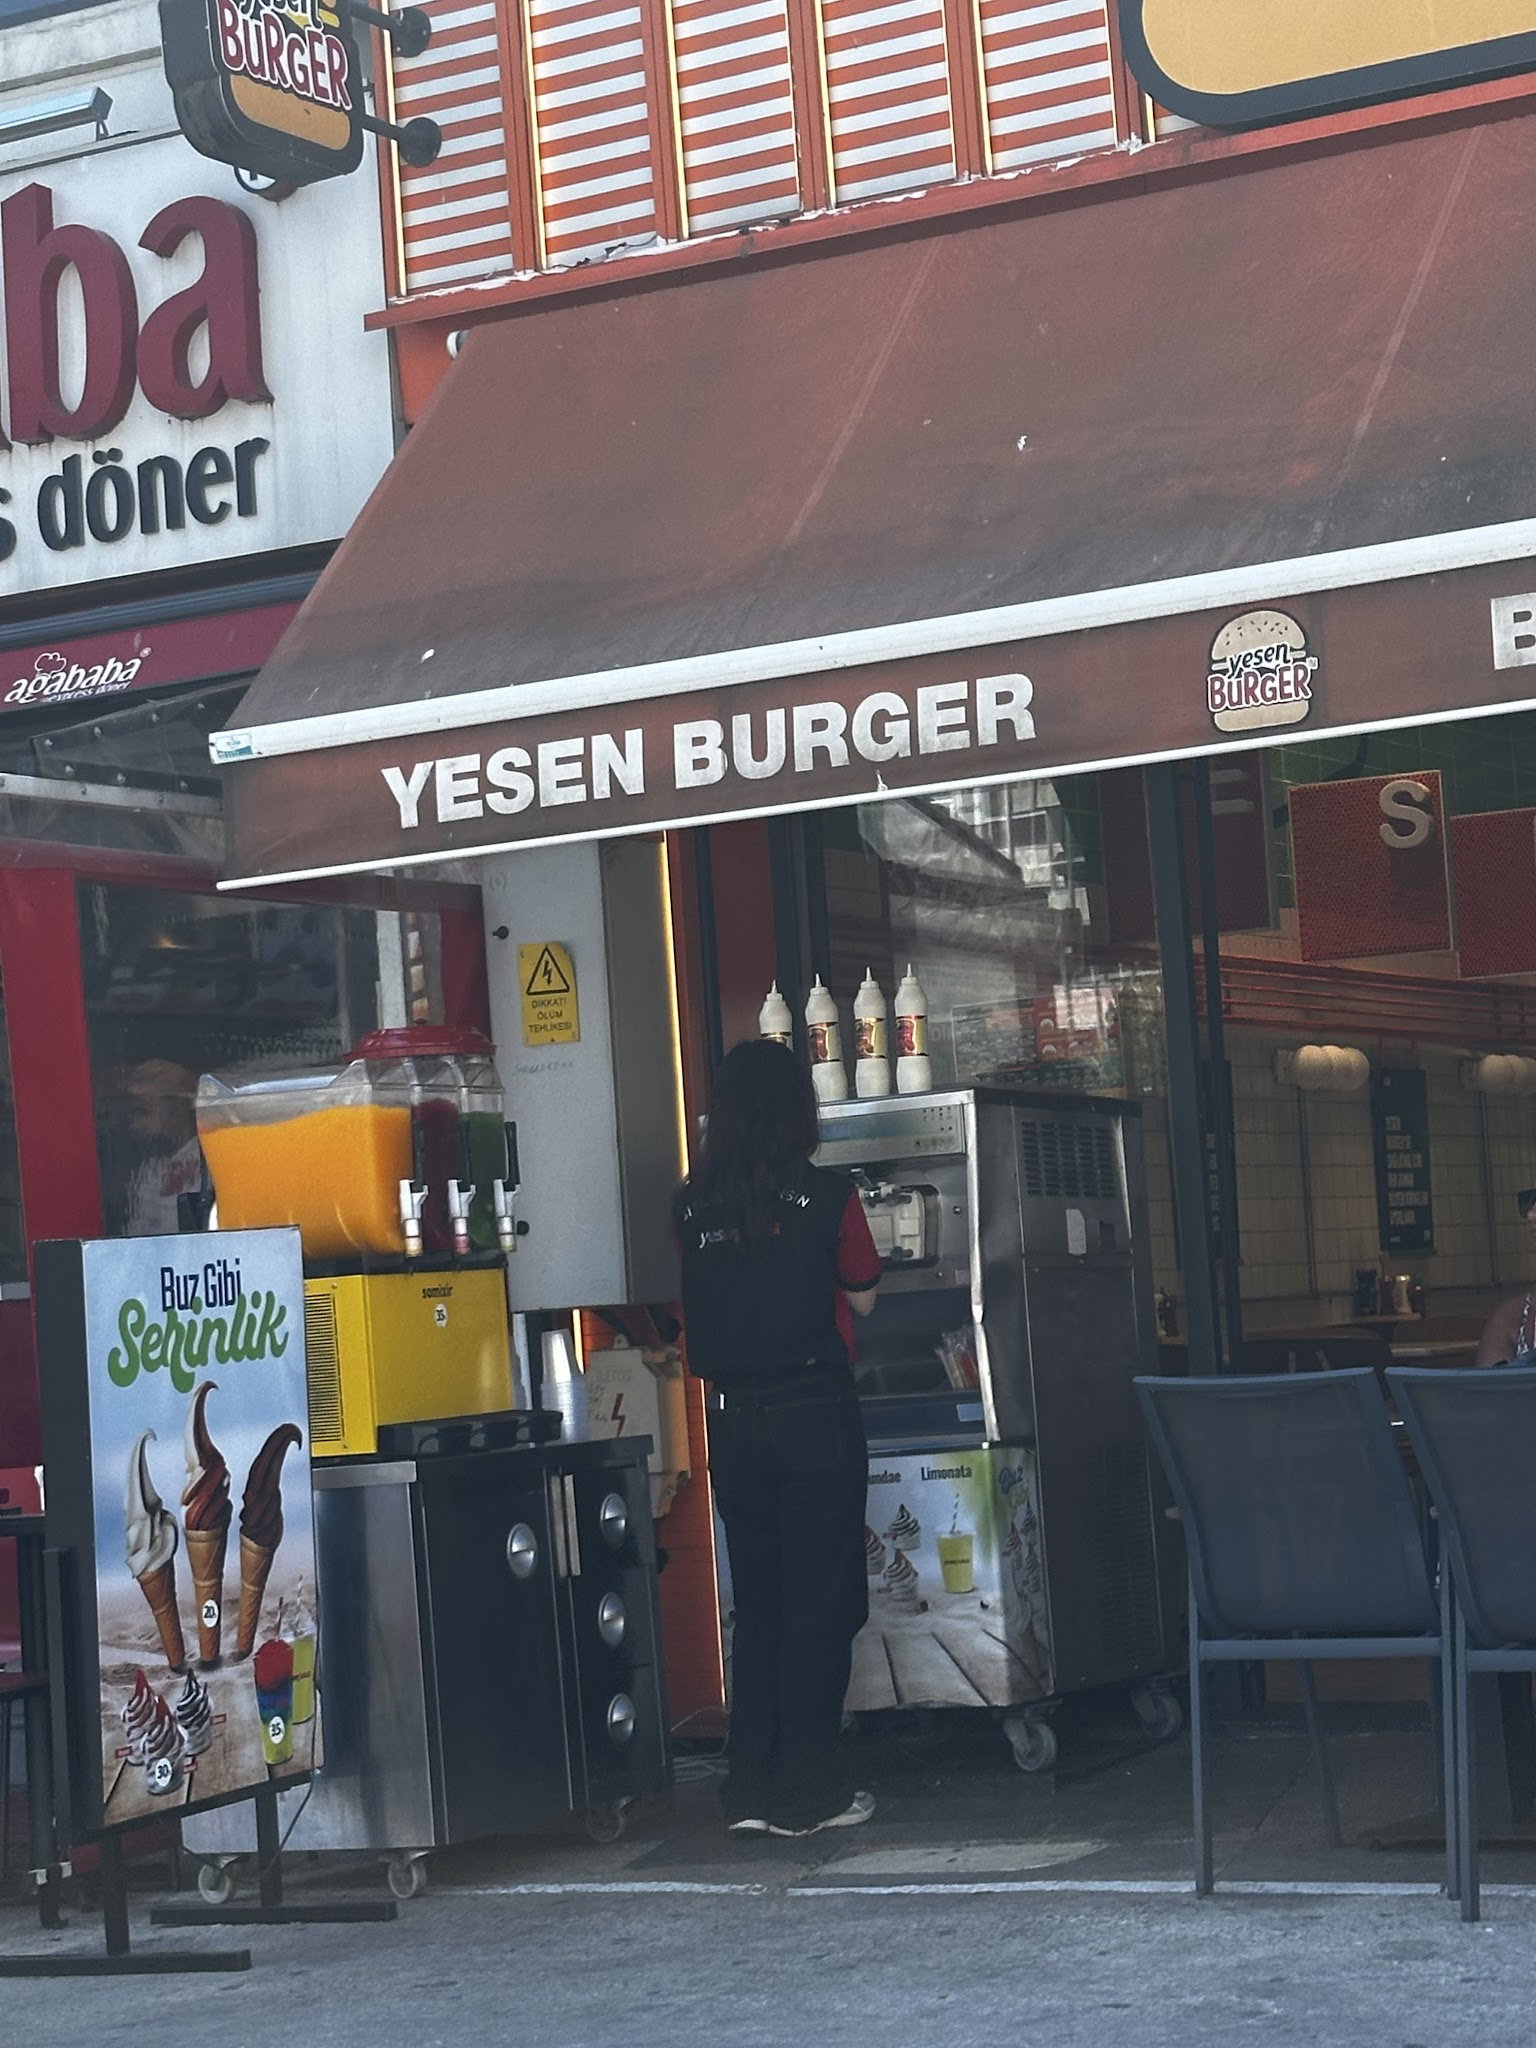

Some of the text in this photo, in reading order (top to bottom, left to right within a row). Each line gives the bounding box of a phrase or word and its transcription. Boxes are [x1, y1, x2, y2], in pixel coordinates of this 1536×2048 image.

[0, 183, 273, 453] ba
[37, 437, 270, 551] döner
[1228, 643, 1290, 679] yesen
[382, 673, 1036, 829] YESEN BURGER
[1379, 779, 1430, 849] S
[160, 1257, 241, 1312] Buz Gibi
[108, 1290, 289, 1393] Serinlik
[868, 1469, 902, 1485] undae
[921, 1464, 972, 1481] Limonata
[204, 1605, 216, 1619] 20
[157, 1764, 169, 1780] 30
